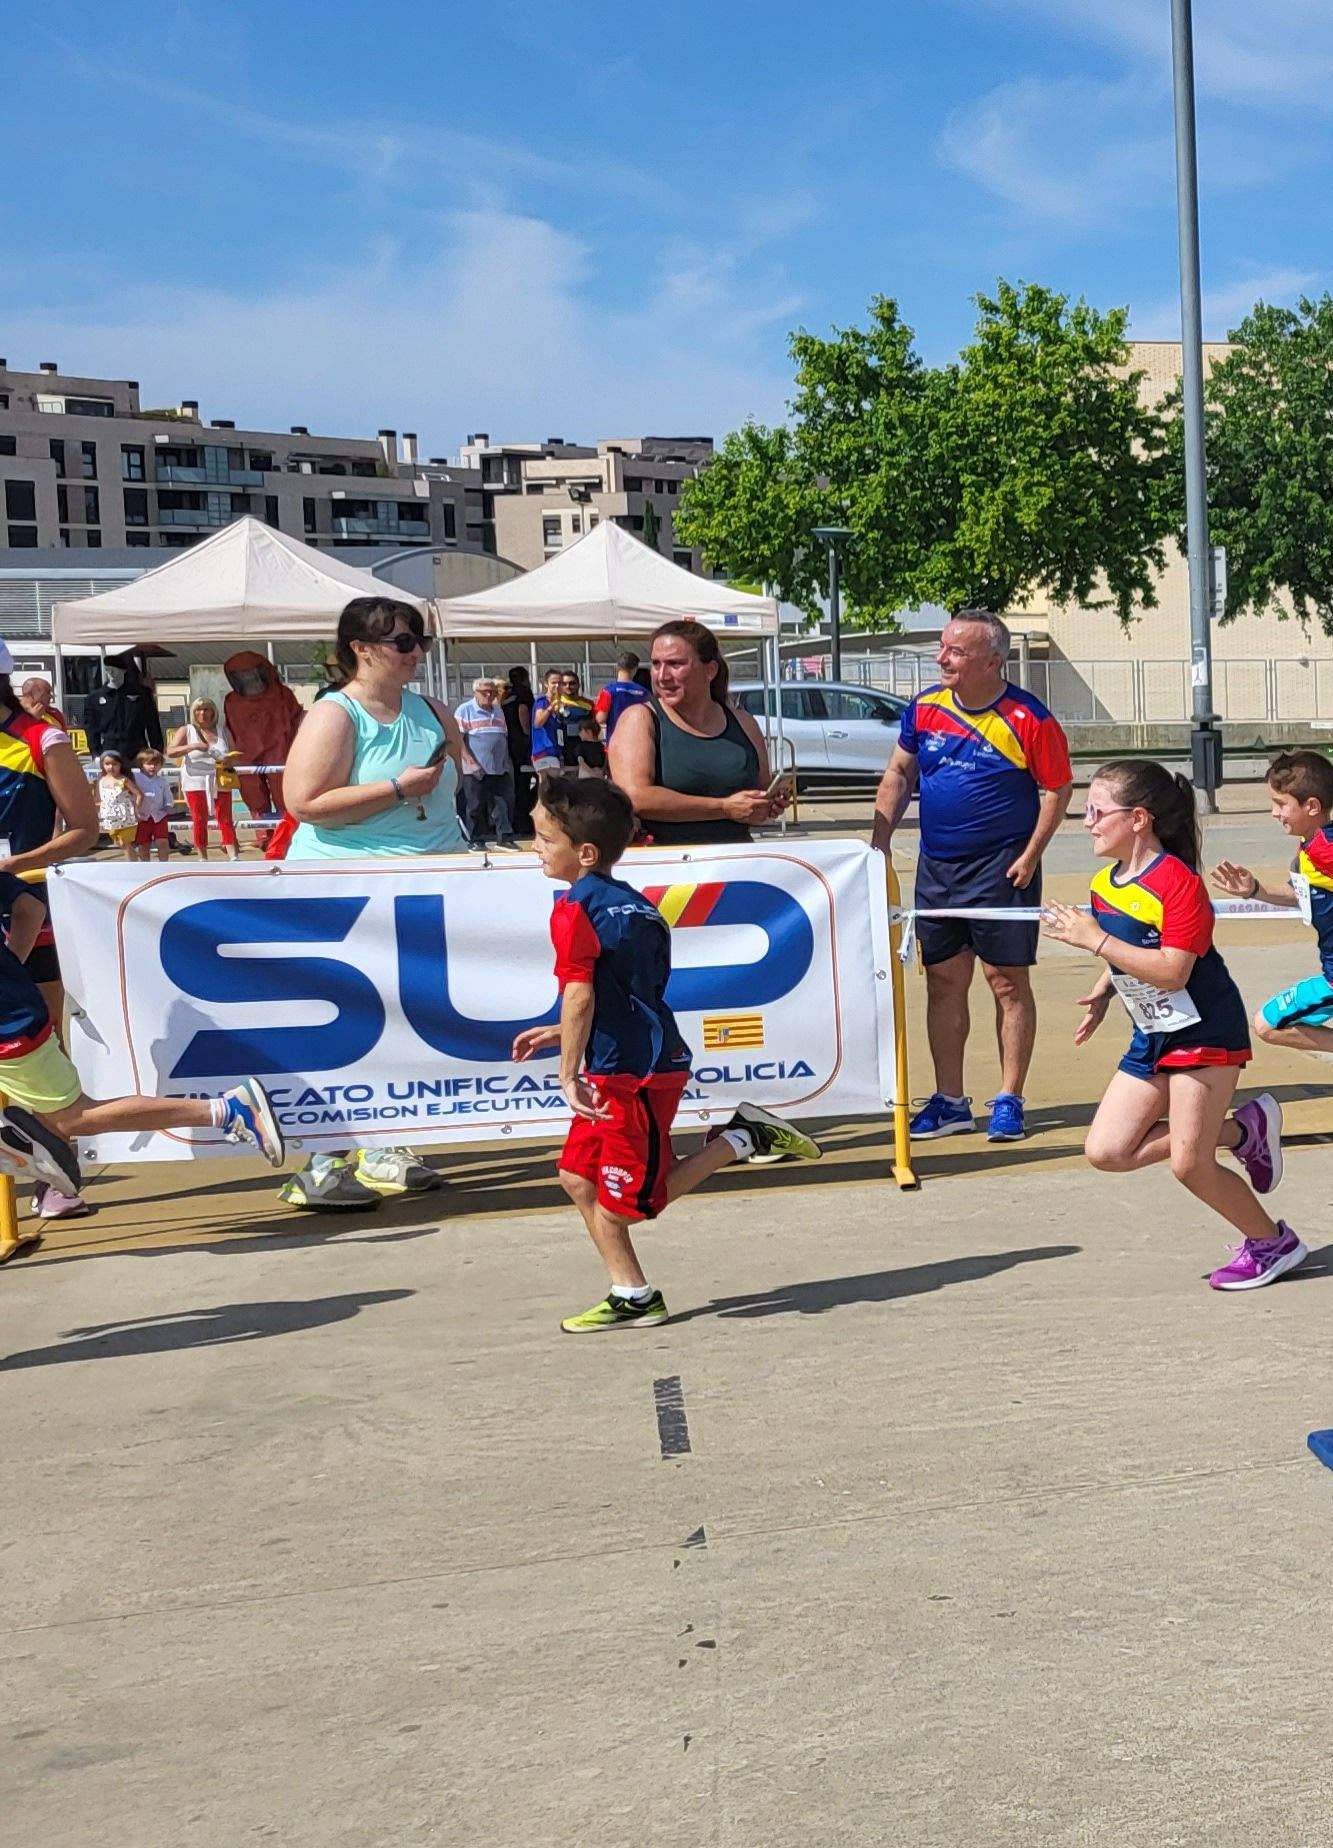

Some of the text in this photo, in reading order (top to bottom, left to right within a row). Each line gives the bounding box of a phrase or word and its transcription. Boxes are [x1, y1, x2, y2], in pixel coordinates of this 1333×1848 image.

[160, 880, 814, 1079] SUP
[387, 1073, 564, 1100] UNIFICAD
[426, 1095, 569, 1117] EJECUTIVA
